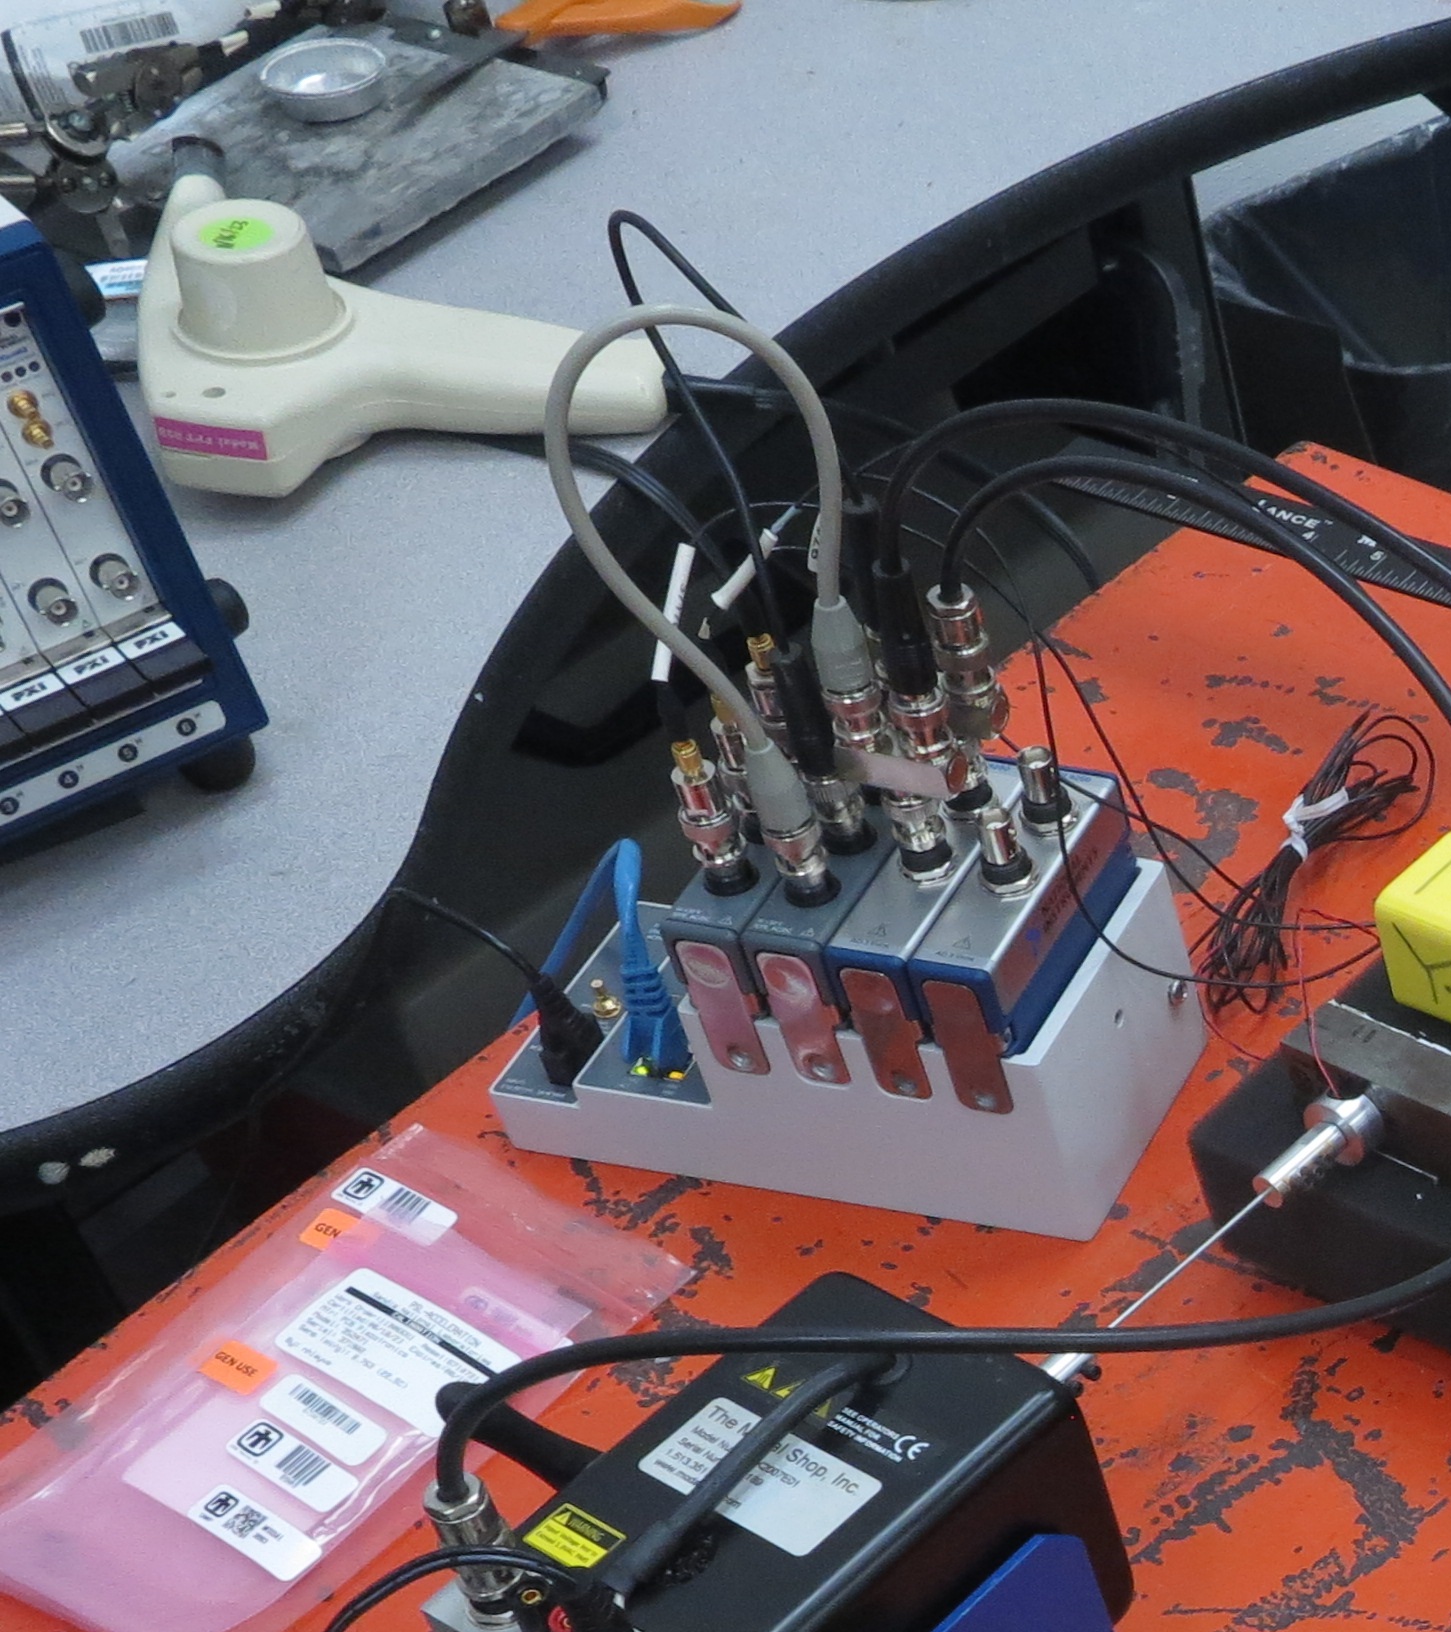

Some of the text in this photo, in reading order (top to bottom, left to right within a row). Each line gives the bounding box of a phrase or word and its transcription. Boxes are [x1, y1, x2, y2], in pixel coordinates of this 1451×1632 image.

[1370, 549, 1384, 562] 5
[133, 629, 169, 650] PXI
[73, 654, 110, 676] PXI
[12, 681, 46, 702] PXI
[313, 1221, 342, 1240] GEN
[214, 1350, 259, 1378] GEN USE
[703, 1404, 744, 1430] The
[780, 1446, 837, 1482] Shop,
[829, 1471, 867, 1496] Inc.
